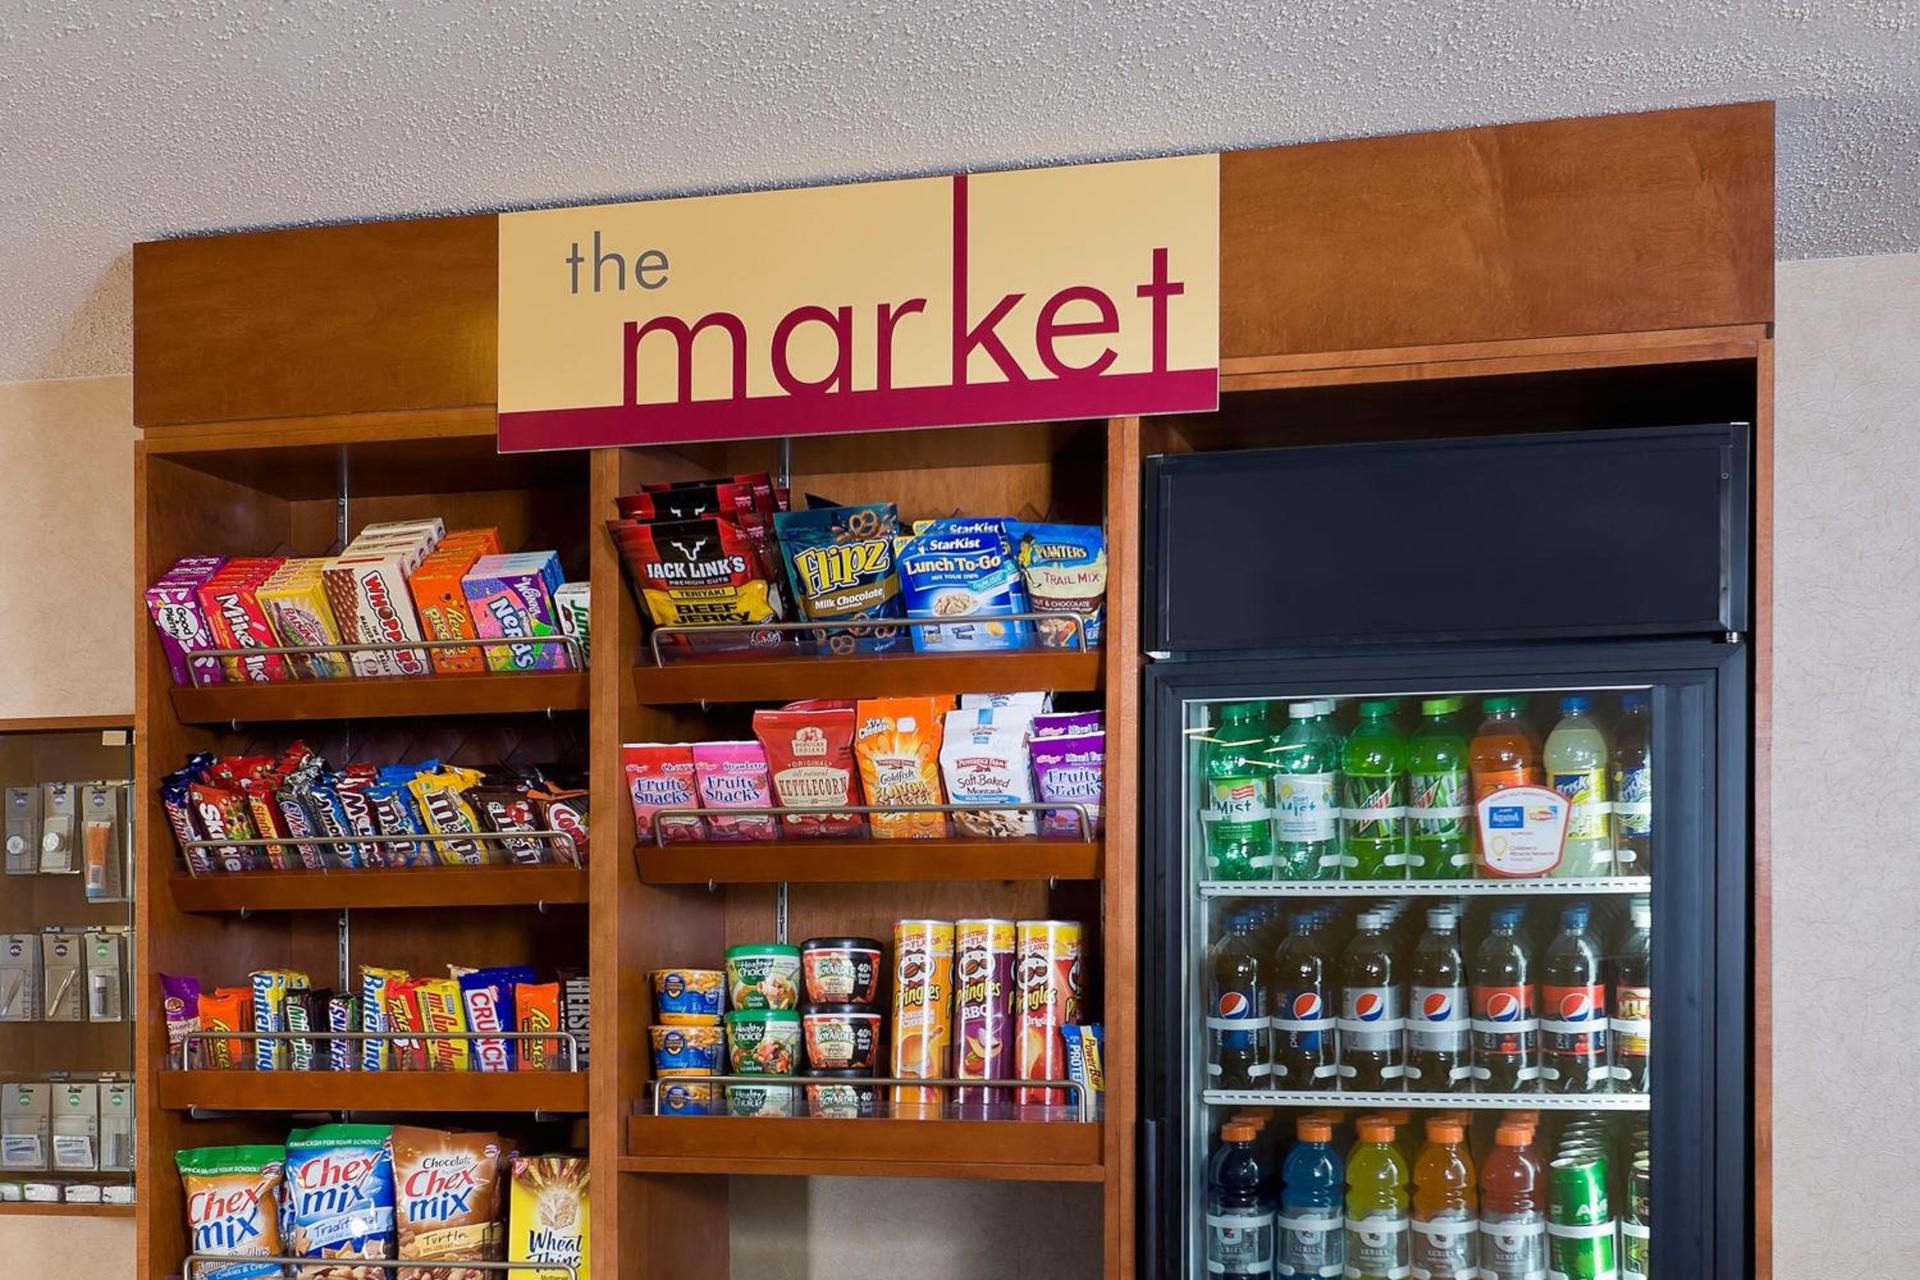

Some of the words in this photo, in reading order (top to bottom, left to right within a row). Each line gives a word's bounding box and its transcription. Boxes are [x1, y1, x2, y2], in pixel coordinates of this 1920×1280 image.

[566, 231, 670, 294] the
[623, 174, 1185, 407] market
[930, 539, 980, 551] StarKist
[647, 562, 688, 579] JACK
[690, 556, 746, 579] LINK'S
[795, 539, 890, 599] Flipz
[905, 557, 954, 575] Lunch
[1043, 572, 1075, 585] TRAIL
[1077, 572, 1100, 584] MIX
[679, 589, 726, 597] TERIYAKI
[815, 600, 835, 610] Milk
[837, 588, 884, 606] Chocolate
[676, 602, 736, 614] BEEF
[364, 574, 421, 673] WHOPPRS
[674, 611, 750, 625] JERKY
[792, 760, 829, 768] ORIGINAL
[706, 775, 756, 791] Fruity
[880, 769, 915, 785] Goldfish
[957, 775, 977, 788] Soft
[978, 774, 1011, 788] Baked
[705, 788, 761, 802] Snacks
[778, 776, 847, 797] KETTLECORN
[1046, 782, 1104, 796] Snacks
[634, 790, 691, 804] Snacks
[297, 1152, 382, 1190] Chex
[423, 1156, 472, 1169] Chocolate
[404, 1163, 478, 1198] Chex
[188, 1179, 270, 1227] Chex
[302, 1182, 365, 1217] mix
[408, 1186, 473, 1222] mix
[195, 1204, 260, 1251] mix
[423, 1230, 468, 1246] Turtle
[529, 1227, 583, 1253] Wheat
